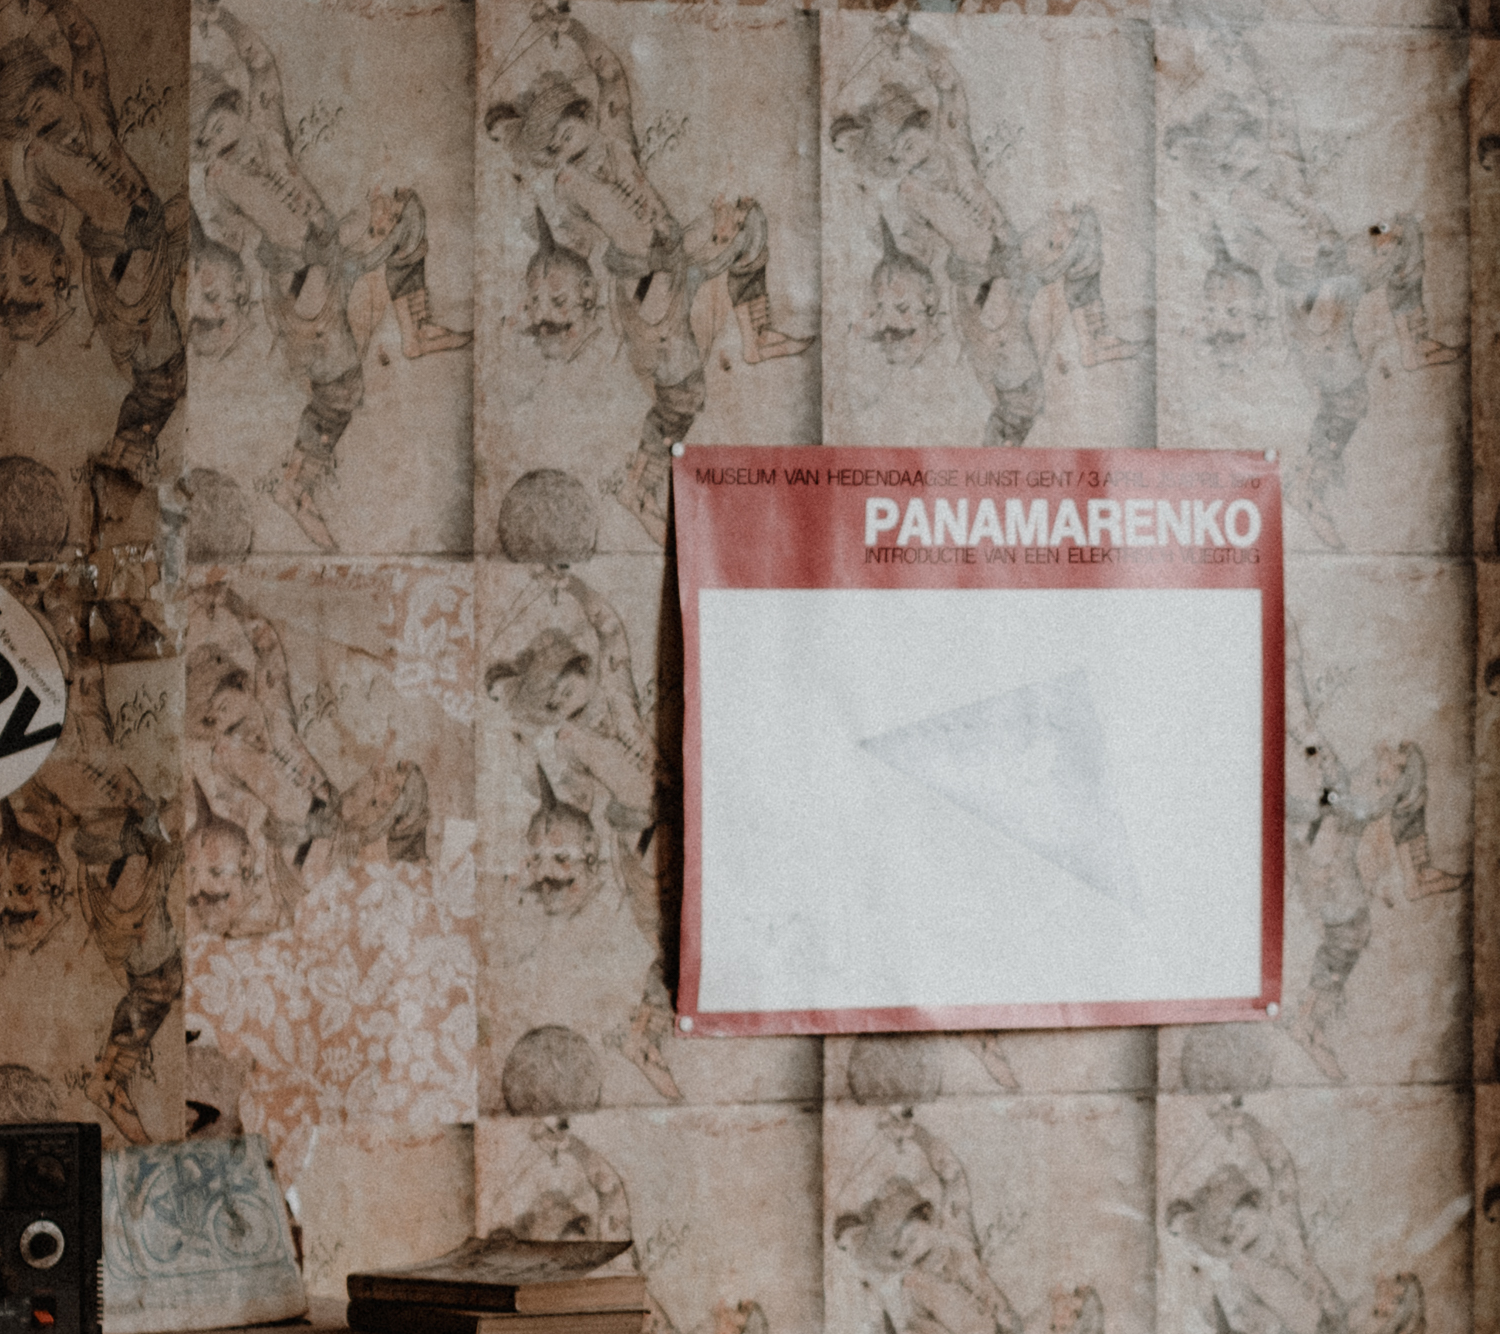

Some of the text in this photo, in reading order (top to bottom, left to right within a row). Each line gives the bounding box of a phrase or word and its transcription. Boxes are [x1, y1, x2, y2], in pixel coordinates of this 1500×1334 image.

[696, 468, 776, 486] MUSEUM
[783, 468, 820, 486] VAN
[826, 468, 959, 487] HEDENDAAGSE
[964, 469, 1021, 488] KUNST
[1026, 470, 1074, 488] GENT
[1087, 471, 1101, 488] 3
[864, 496, 1262, 548] PANAMARENKO
[864, 547, 977, 565] INTRODUCTIE
[984, 547, 1017, 565] VAN
[1024, 547, 1060, 565] EEN
